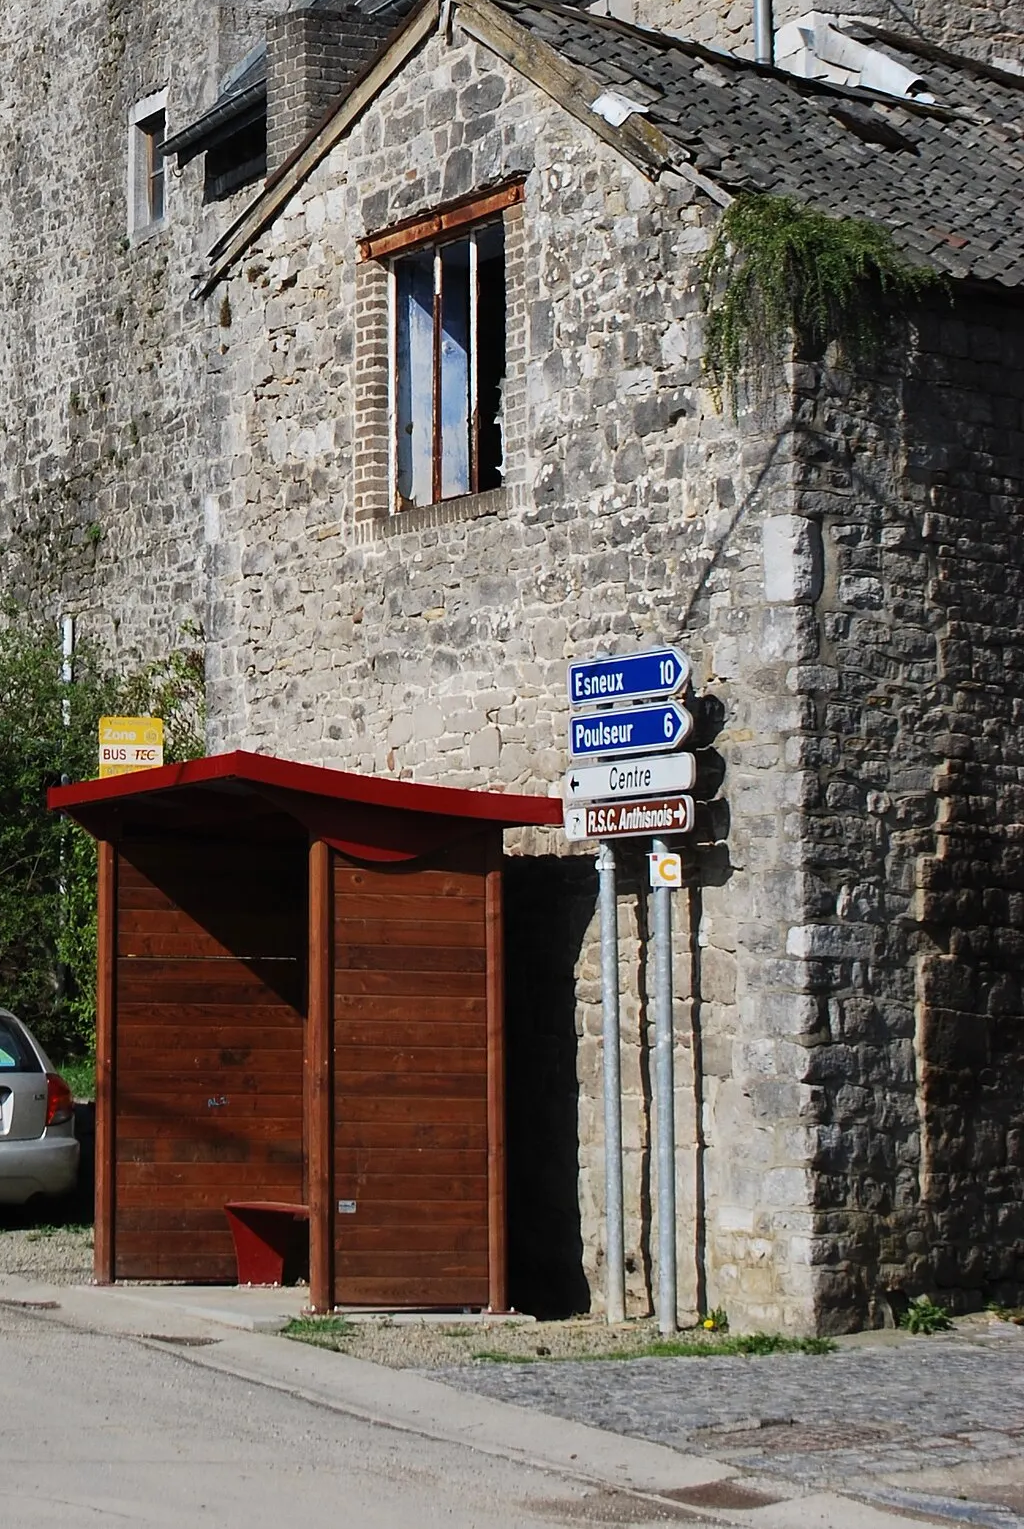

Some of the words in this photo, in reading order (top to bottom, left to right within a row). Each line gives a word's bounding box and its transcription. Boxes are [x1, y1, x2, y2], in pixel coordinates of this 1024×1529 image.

[575, 671, 624, 697] Esneux
[659, 659, 674, 685] 10
[103, 728, 137, 741] Zone
[575, 721, 634, 749] Poulseur
[663, 713, 674, 738] 6
[103, 748, 126, 760] BUS
[135, 749, 156, 761] TEC
[609, 767, 651, 791] Centre
[587, 808, 617, 833] R.S.C.
[619, 803, 674, 830] Anthisnois
[658, 858, 678, 881] C
